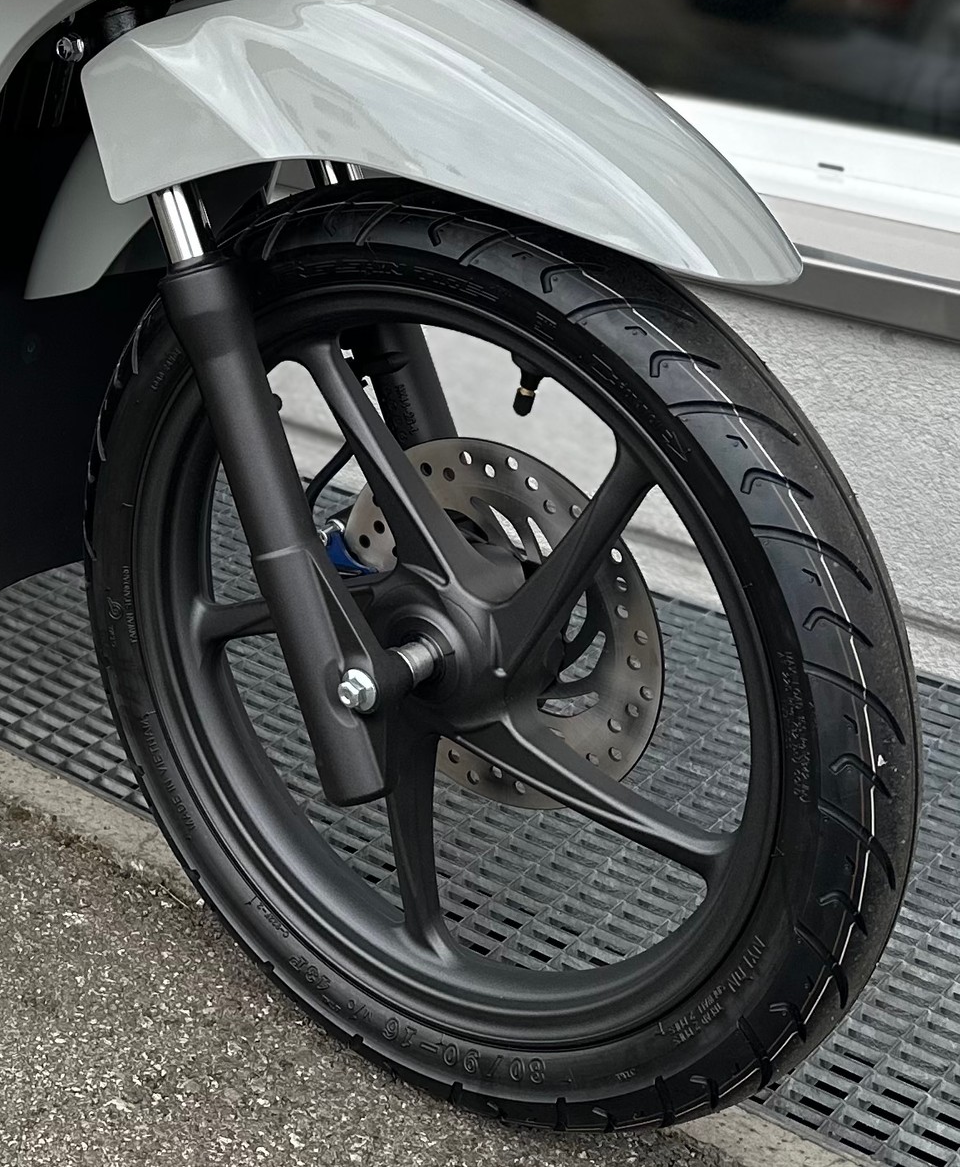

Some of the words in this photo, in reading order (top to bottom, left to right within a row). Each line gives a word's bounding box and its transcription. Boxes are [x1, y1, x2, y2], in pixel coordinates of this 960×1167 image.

[140, 717, 168, 776] VIETNAM
[162, 777, 177, 793] IN
[168, 793, 197, 832] MADE
[288, 955, 331, 991] 43P
